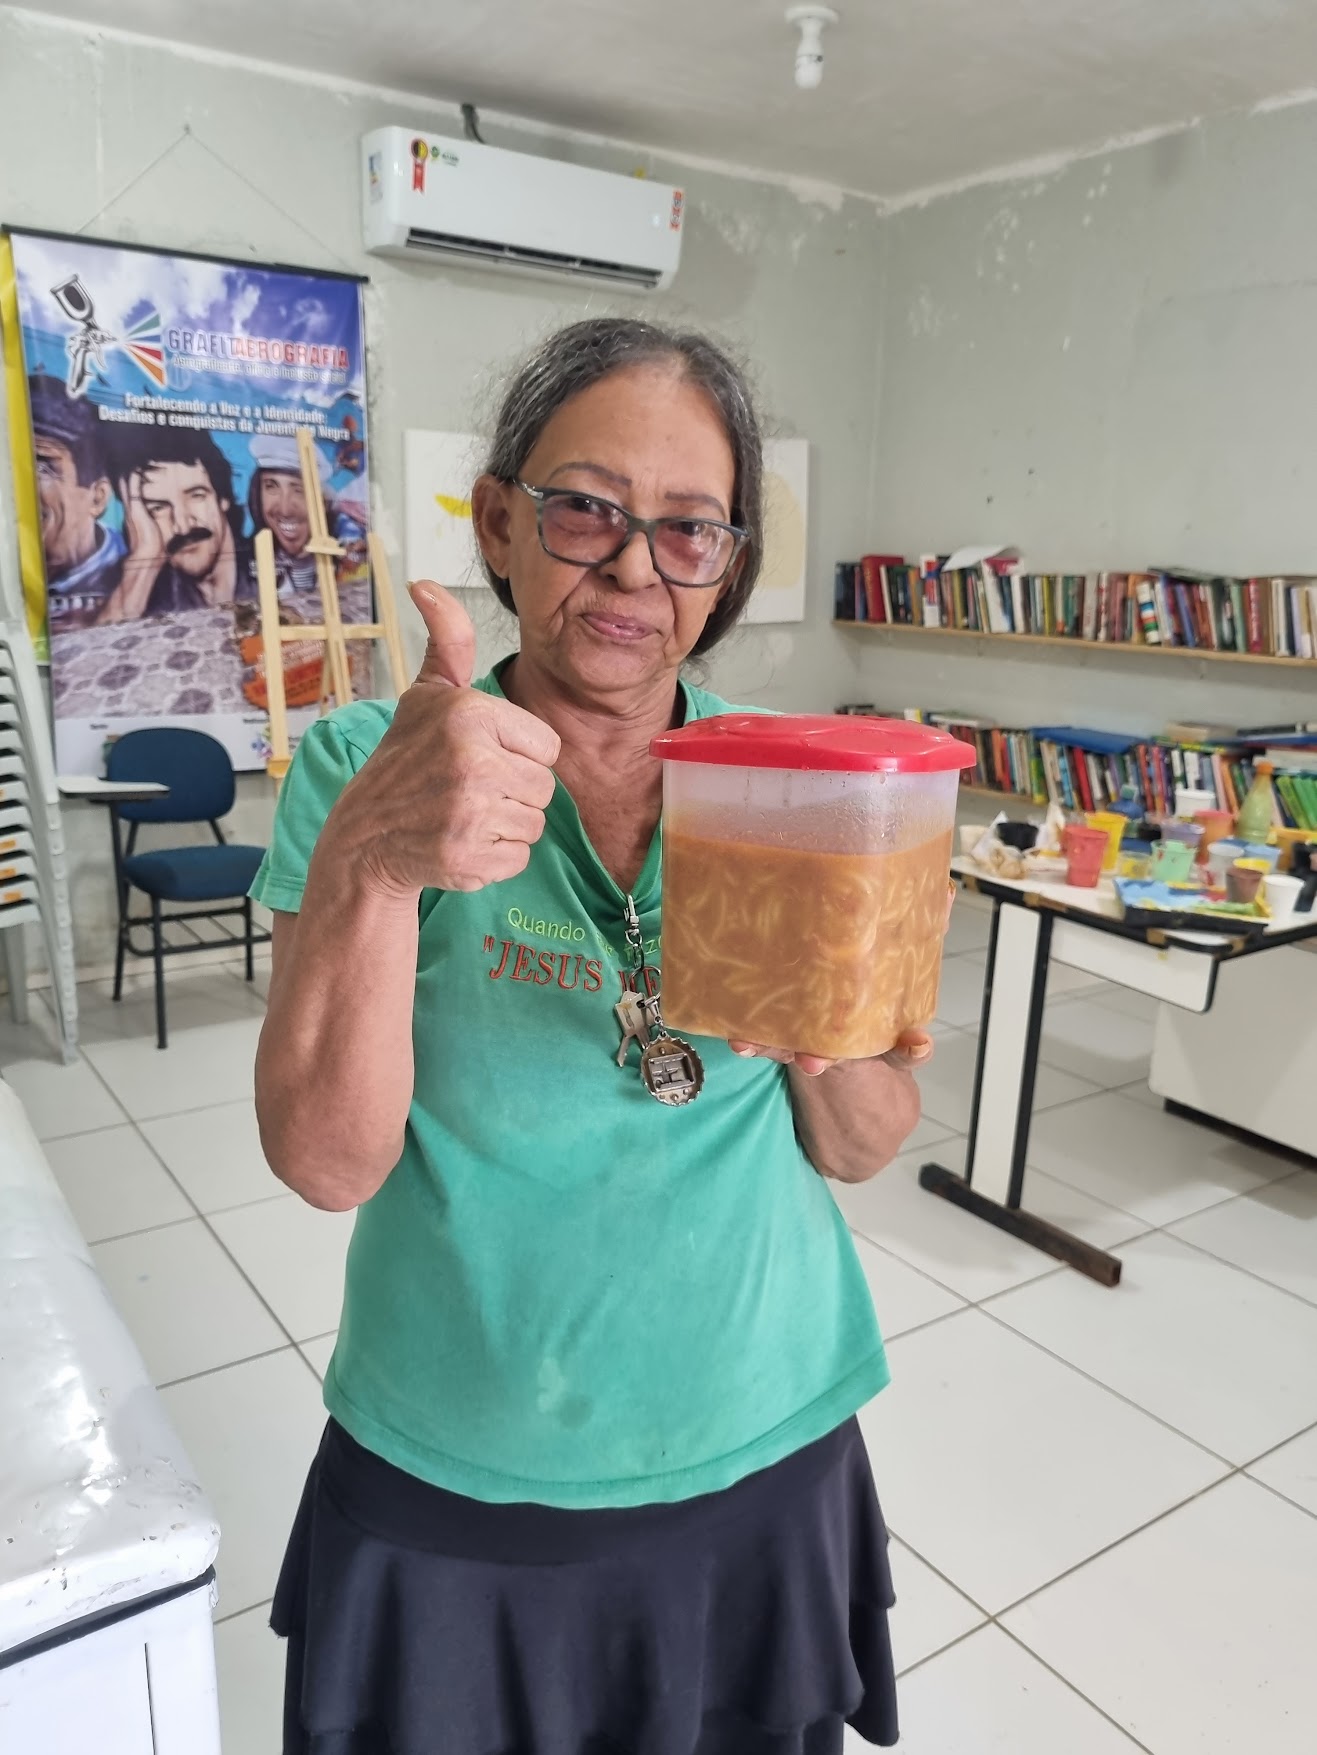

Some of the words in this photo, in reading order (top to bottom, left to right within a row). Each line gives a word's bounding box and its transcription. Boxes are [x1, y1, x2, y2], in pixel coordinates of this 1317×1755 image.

[125, 393, 207, 413] Fortalecendo
[209, 402, 218, 415] a
[220, 401, 241, 417] Voz
[242, 406, 252, 418] e
[99, 405, 155, 425] Desafios
[157, 413, 166, 426] e
[168, 413, 236, 431] conquistas
[239, 418, 253, 433] da
[318, 425, 350, 442] Negra
[507, 907, 586, 942] Quando
